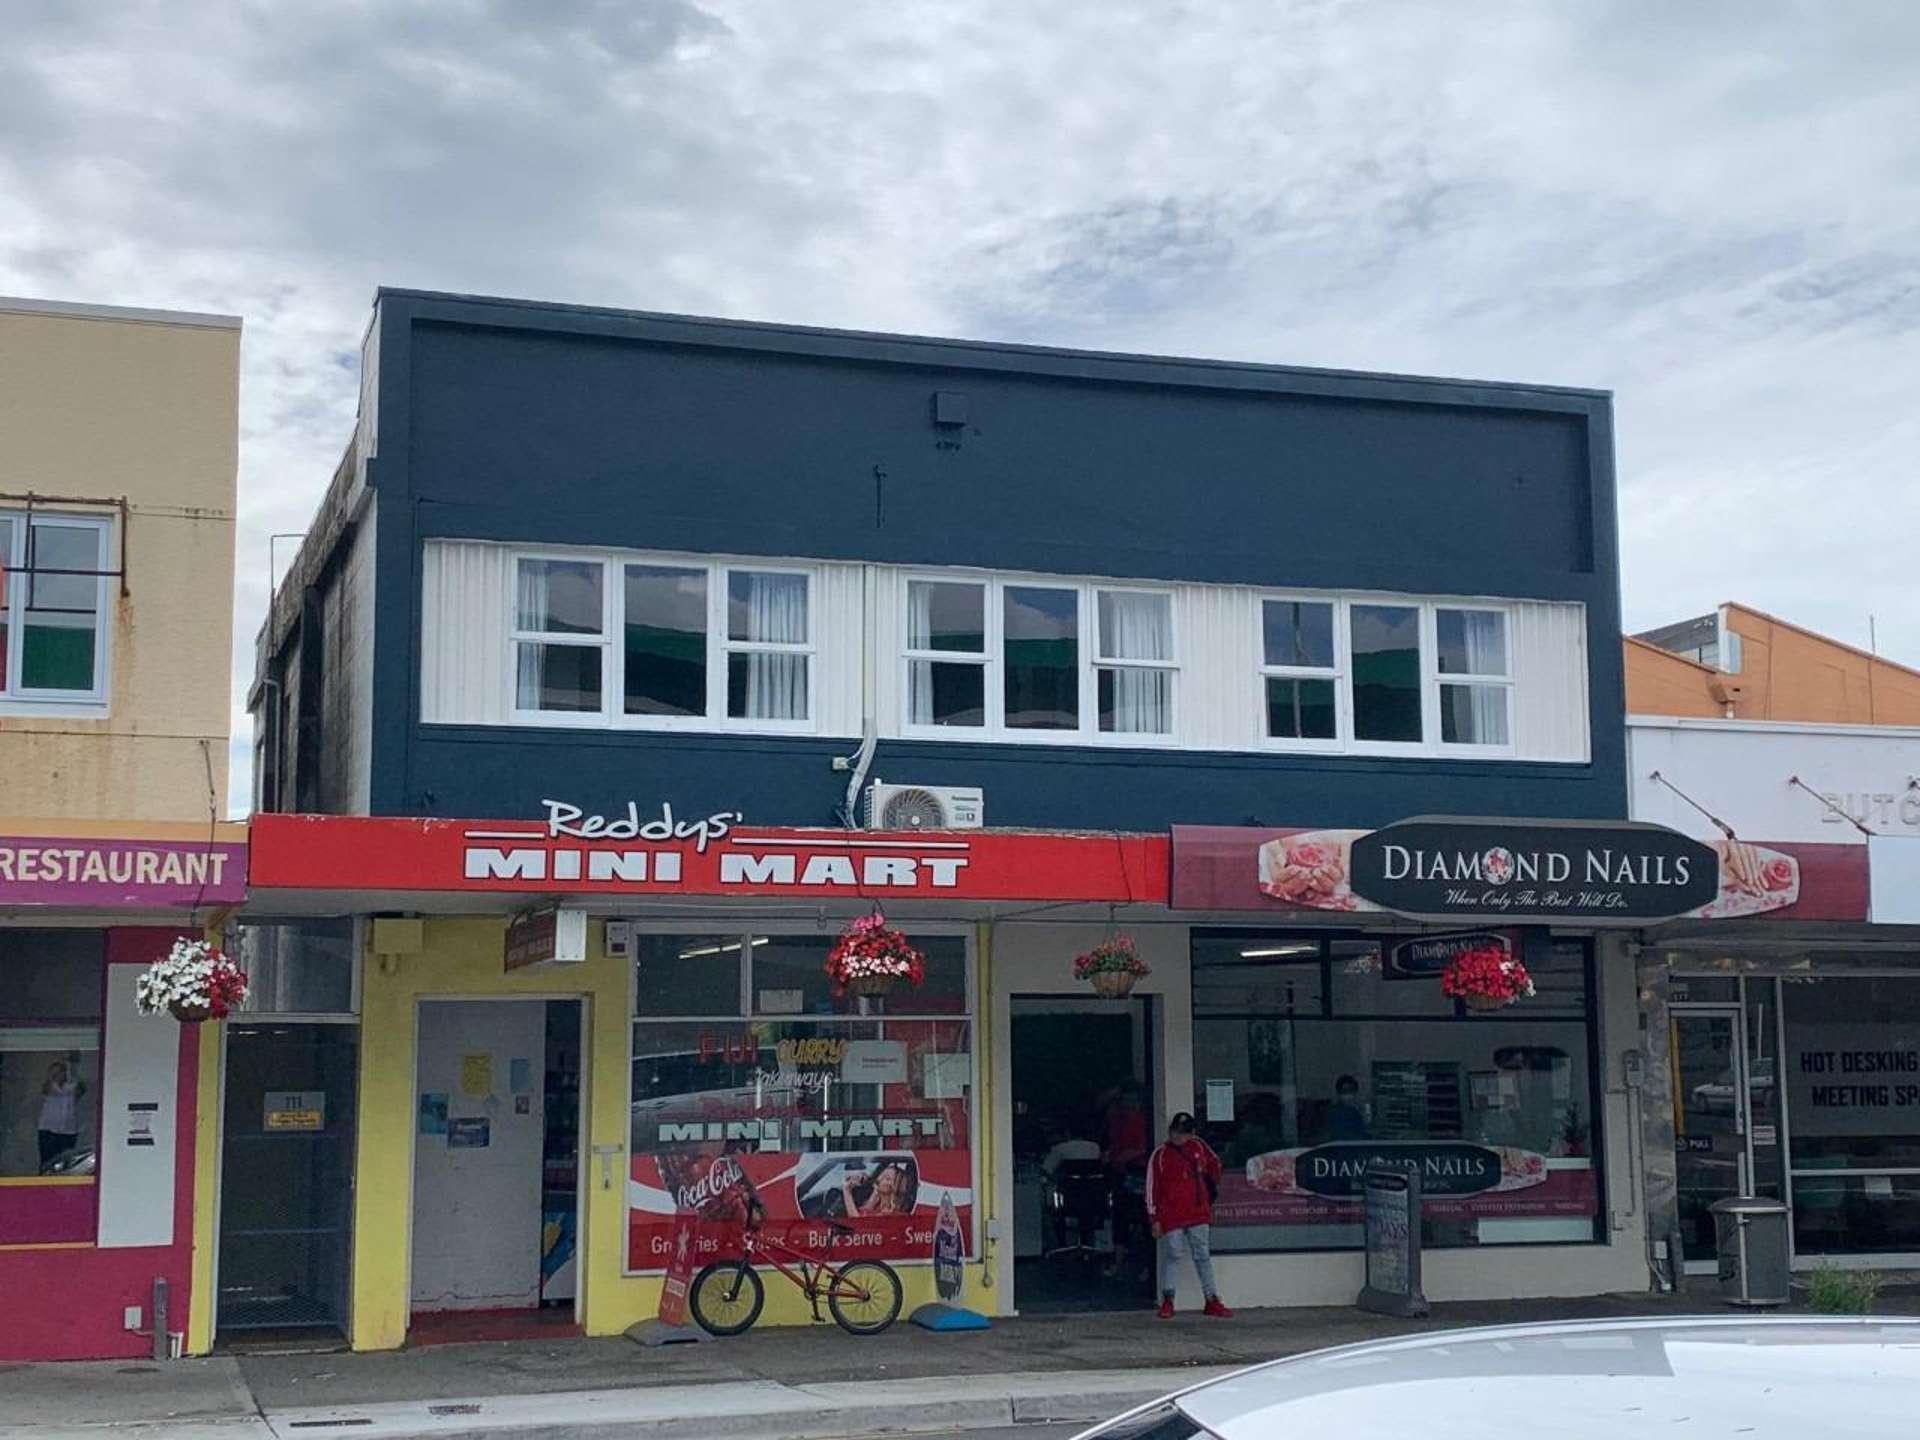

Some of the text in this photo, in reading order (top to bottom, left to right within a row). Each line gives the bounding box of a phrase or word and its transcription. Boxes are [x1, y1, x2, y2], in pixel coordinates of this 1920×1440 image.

[0, 848, 229, 885] RESTAURANT
[464, 848, 969, 888] MINI MART
[1381, 845, 1690, 886] DIAMOND NAILS
[1444, 888, 1478, 905] When
[1482, 890, 1511, 911] Only
[1514, 890, 1537, 906] The
[1540, 890, 1573, 907] Best
[1576, 891, 1605, 908] Will
[1800, 1051, 1918, 1073] HOT DESKING
[1811, 1085, 1920, 1107] MEETING SP
[658, 1118, 943, 1142] MINI MART
[1426, 1156, 1485, 1177] NAILS
[905, 1226, 933, 1244] Swe
